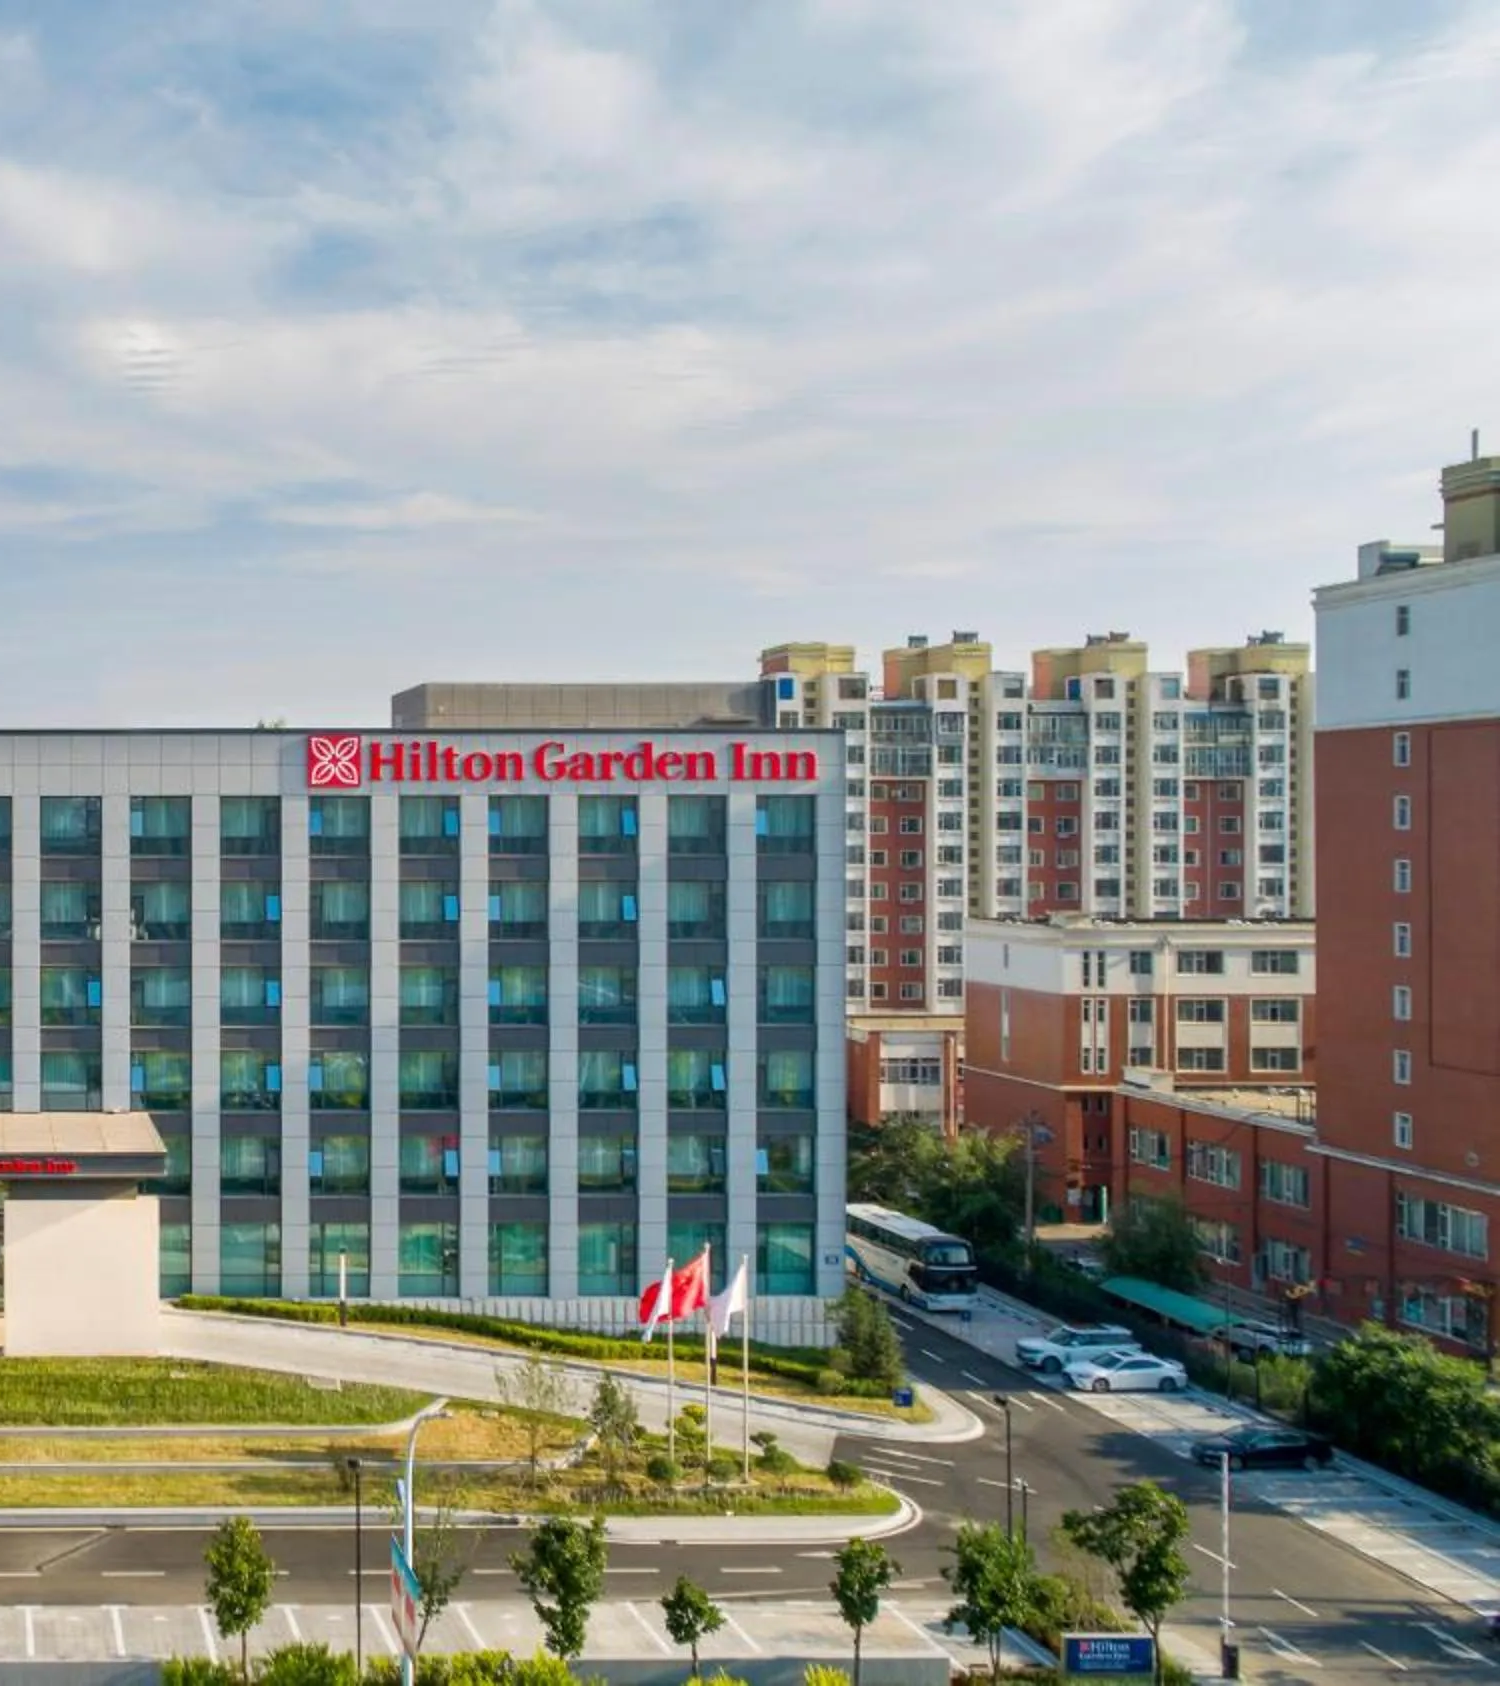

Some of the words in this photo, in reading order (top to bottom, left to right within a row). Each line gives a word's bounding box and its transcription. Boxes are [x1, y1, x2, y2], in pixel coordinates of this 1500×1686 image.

[368, 741, 525, 782] Hilton
[532, 741, 718, 782] Garden
[730, 741, 820, 782] Inn
